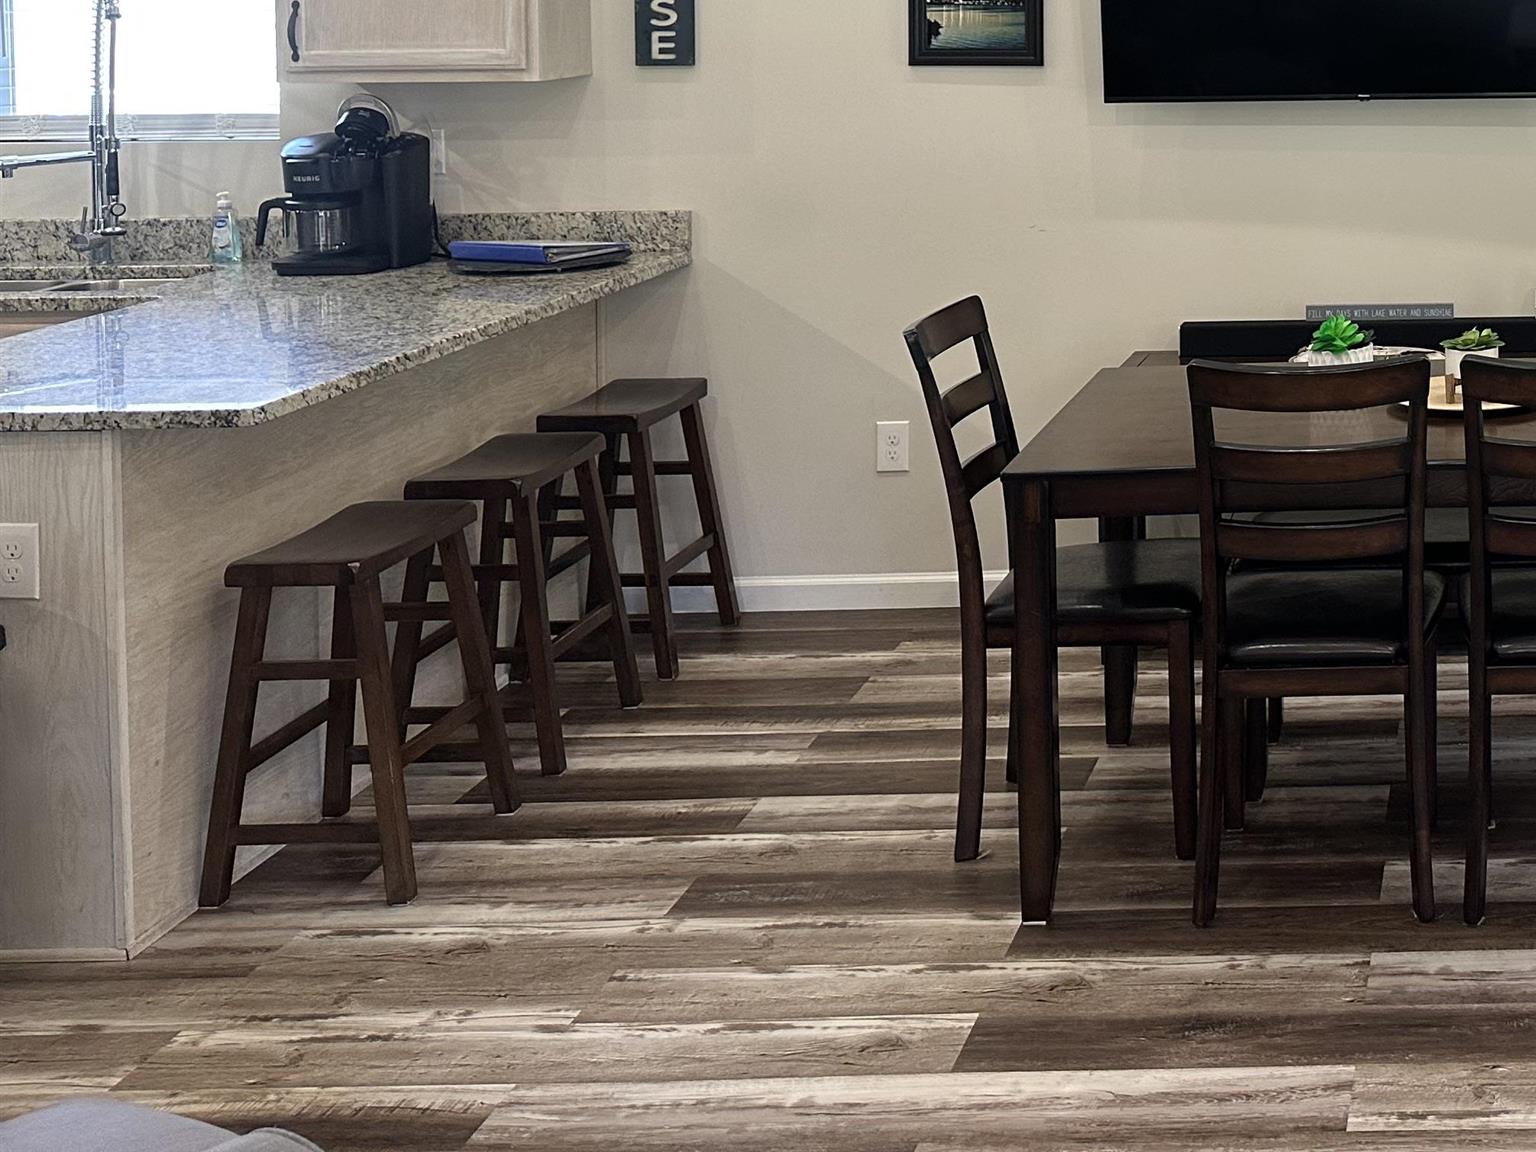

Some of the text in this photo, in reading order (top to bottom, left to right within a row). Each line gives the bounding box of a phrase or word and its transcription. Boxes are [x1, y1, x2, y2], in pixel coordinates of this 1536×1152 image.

[1307, 309, 1322, 318] FILL
[1354, 309, 1369, 318] WITH
[1371, 309, 1386, 318] LAKE
[1388, 309, 1408, 317] WATER
[1410, 308, 1421, 317] AND
[1423, 308, 1452, 317] SUNSHINE
